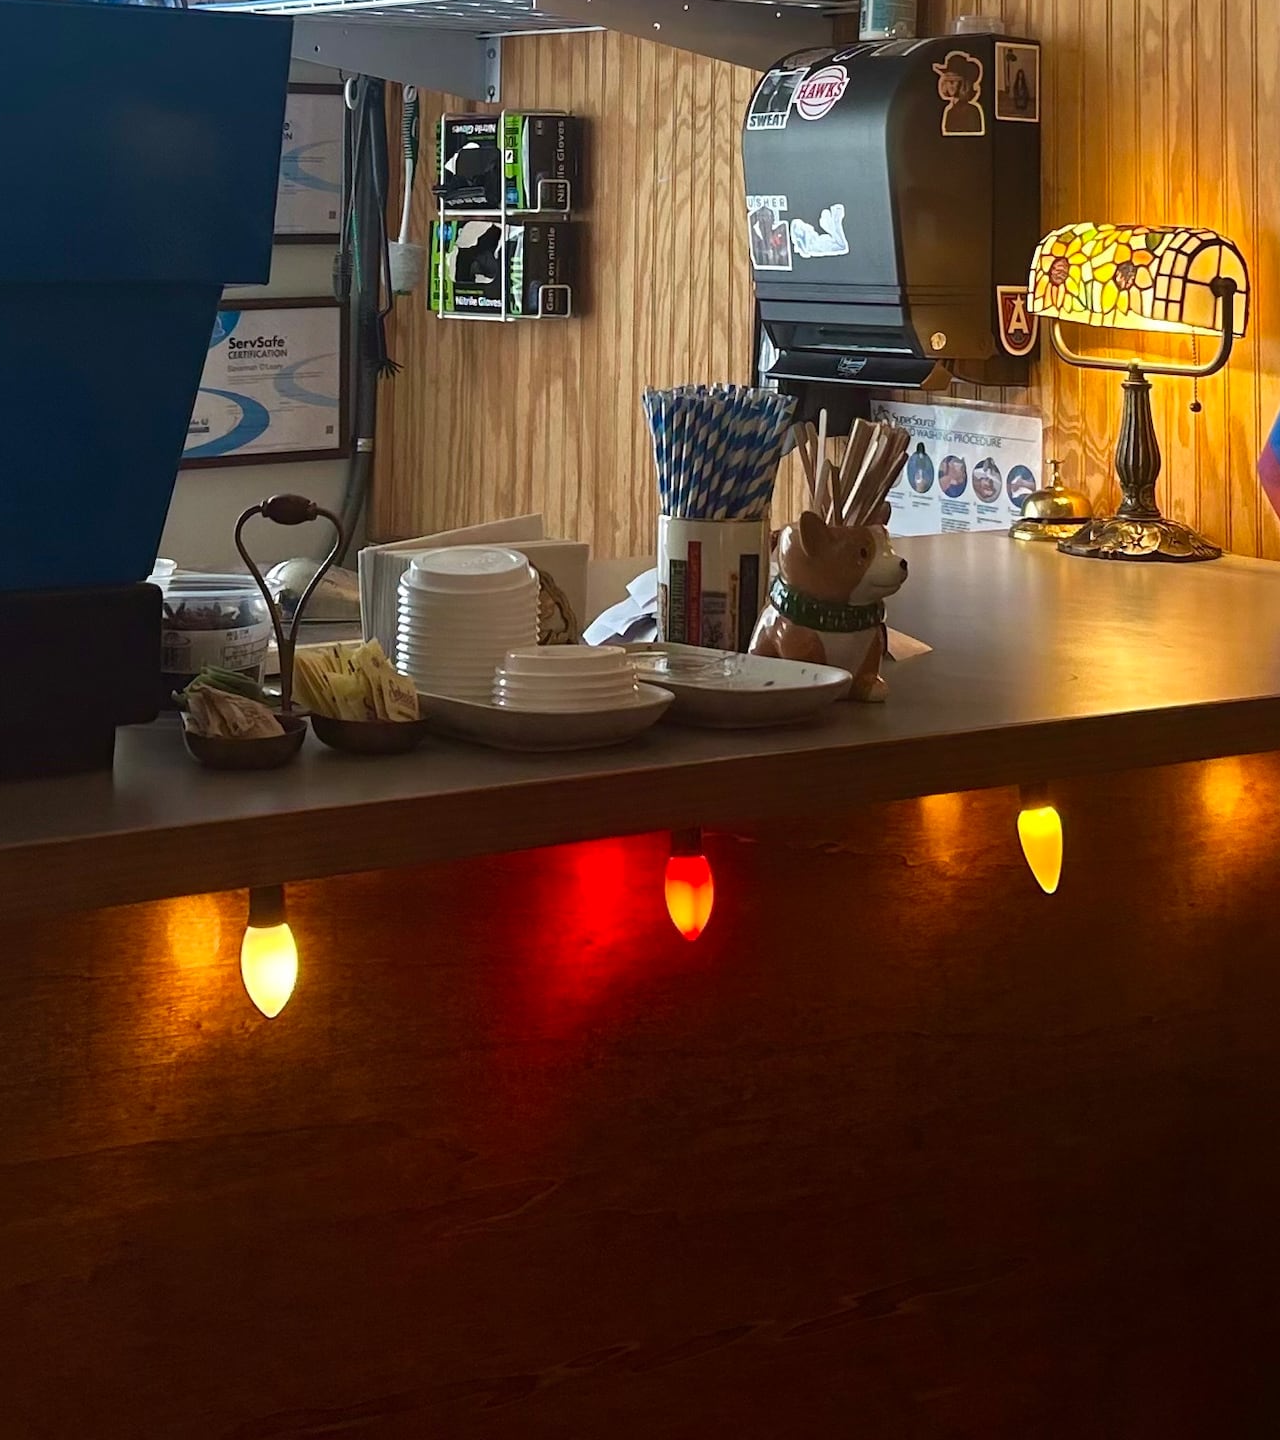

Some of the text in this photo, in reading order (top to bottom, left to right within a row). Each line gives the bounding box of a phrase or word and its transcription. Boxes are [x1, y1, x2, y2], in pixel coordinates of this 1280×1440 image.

[797, 77, 845, 100] HAWKS
[749, 114, 787, 127] SWEAT
[451, 123, 496, 134] Nitrile Gloves
[557, 120, 565, 203] Nitile Gloves
[748, 197, 786, 208] USHER
[547, 226, 556, 259] nitrile
[455, 296, 478, 307] Nitrile
[546, 279, 556, 311] Gans
[228, 335, 286, 350] ServSafe
[227, 348, 288, 360] CERTIFICATION
[916, 430, 952, 443] WASHING
[953, 433, 1002, 449] PROCEDURE
